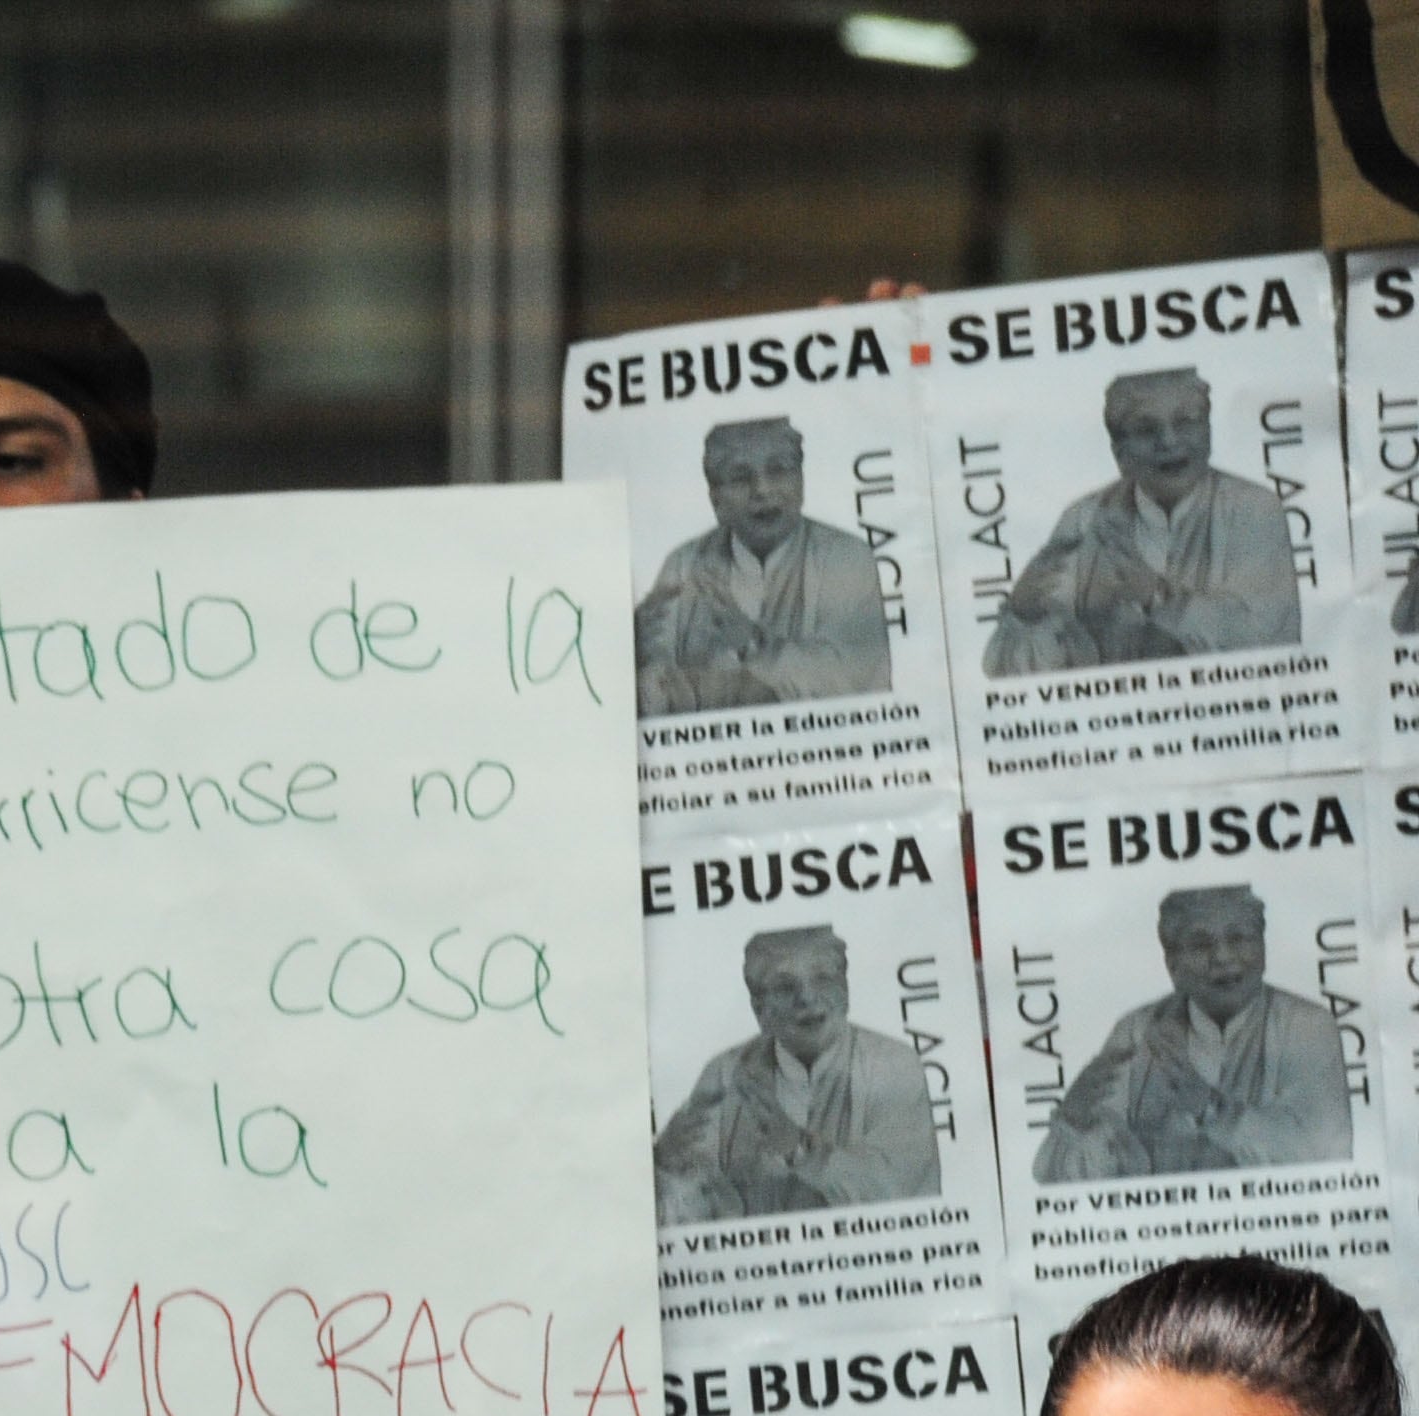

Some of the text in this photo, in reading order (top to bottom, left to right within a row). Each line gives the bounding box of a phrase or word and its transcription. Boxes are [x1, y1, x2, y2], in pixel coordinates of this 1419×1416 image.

[948, 277, 1301, 366] SE BUSCA
[583, 326, 891, 412] SE BUSCA
[958, 436, 1012, 624] ULACIT
[309, 578, 443, 682] de
[505, 574, 604, 707] la
[986, 655, 1330, 711] Por VENDER la Educación
[643, 701, 921, 749] VENDER la Educación
[982, 687, 1339, 745] Pública costarricense para
[684, 743, 864, 777] costarricense
[873, 734, 932, 760] para
[987, 718, 1341, 777] beneficiar a su familia rica
[410, 759, 517, 821] no
[723, 791, 739, 807] a
[747, 786, 776, 803] su
[785, 774, 874, 800] familia
[882, 767, 933, 789] rica
[1003, 794, 1355, 874] SE BUSCA
[692, 836, 934, 911] BUSCA
[269, 927, 566, 1037] cosa
[1012, 944, 1065, 1130] ULACIT
[6, 1108, 97, 1183] a
[211, 1080, 330, 1190] la
[1036, 1170, 1381, 1217] Por VENDER la Educación
[684, 1225, 792, 1252] VENDER
[801, 1222, 824, 1241] la
[833, 1206, 971, 1238] Educación
[1031, 1202, 1390, 1250] Pública costarricense para
[1338, 1235, 1392, 1258] rica
[734, 1252, 914, 1281] costarricense
[922, 1238, 981, 1264] para
[774, 1294, 789, 1310] a
[797, 1291, 827, 1307] su
[835, 1277, 925, 1304] familia
[932, 1270, 984, 1293] rica
[748, 1344, 990, 1415] BUSCA
